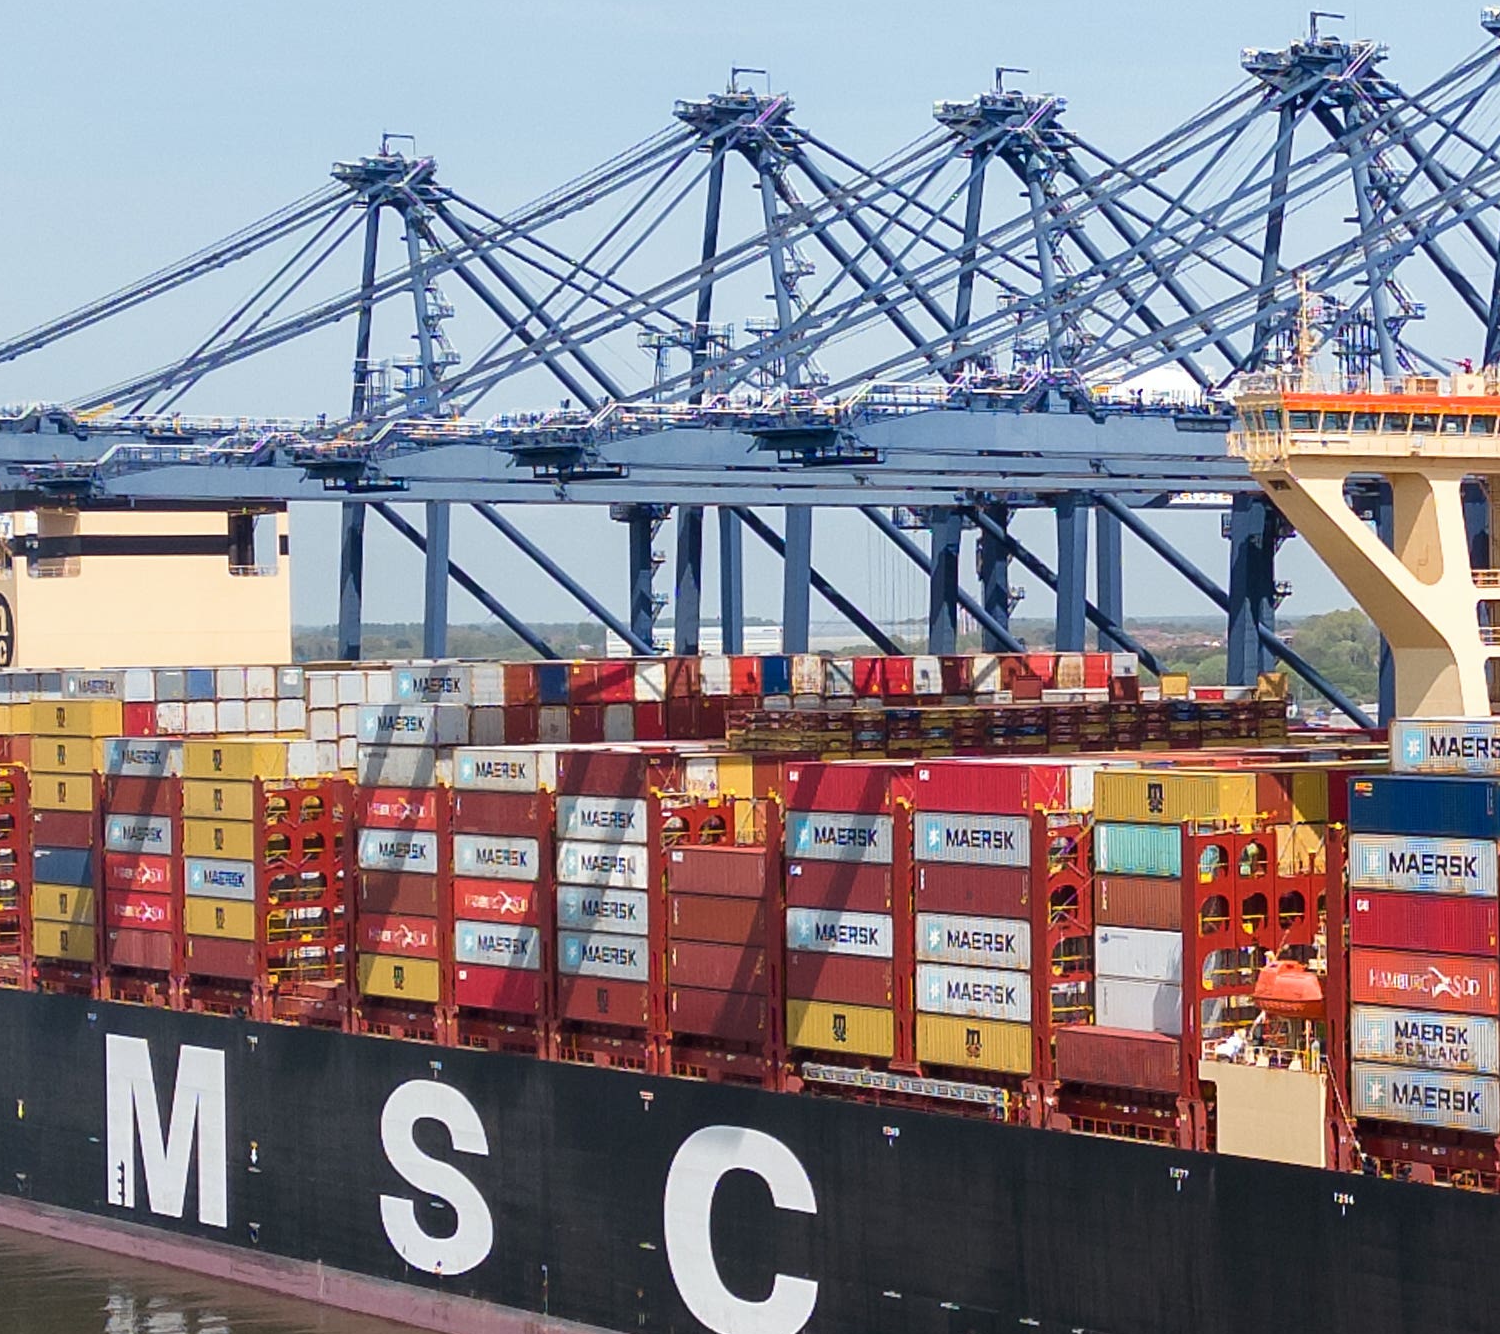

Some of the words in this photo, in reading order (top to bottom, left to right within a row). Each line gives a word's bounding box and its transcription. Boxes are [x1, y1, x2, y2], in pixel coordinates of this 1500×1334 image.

[814, 826, 878, 848] MAERSK
[945, 828, 1014, 850] MAERSK
[1389, 850, 1477, 878] MAERSK
[581, 899, 636, 922] MAERSK
[815, 924, 878, 947] MAERSK
[946, 930, 1016, 953] MAERSK
[581, 942, 637, 966] MAERSK
[946, 981, 1016, 1006] MAERSK
[1394, 1021, 1468, 1044] MAERSK
[1393, 1081, 1480, 1114] MAERSK
